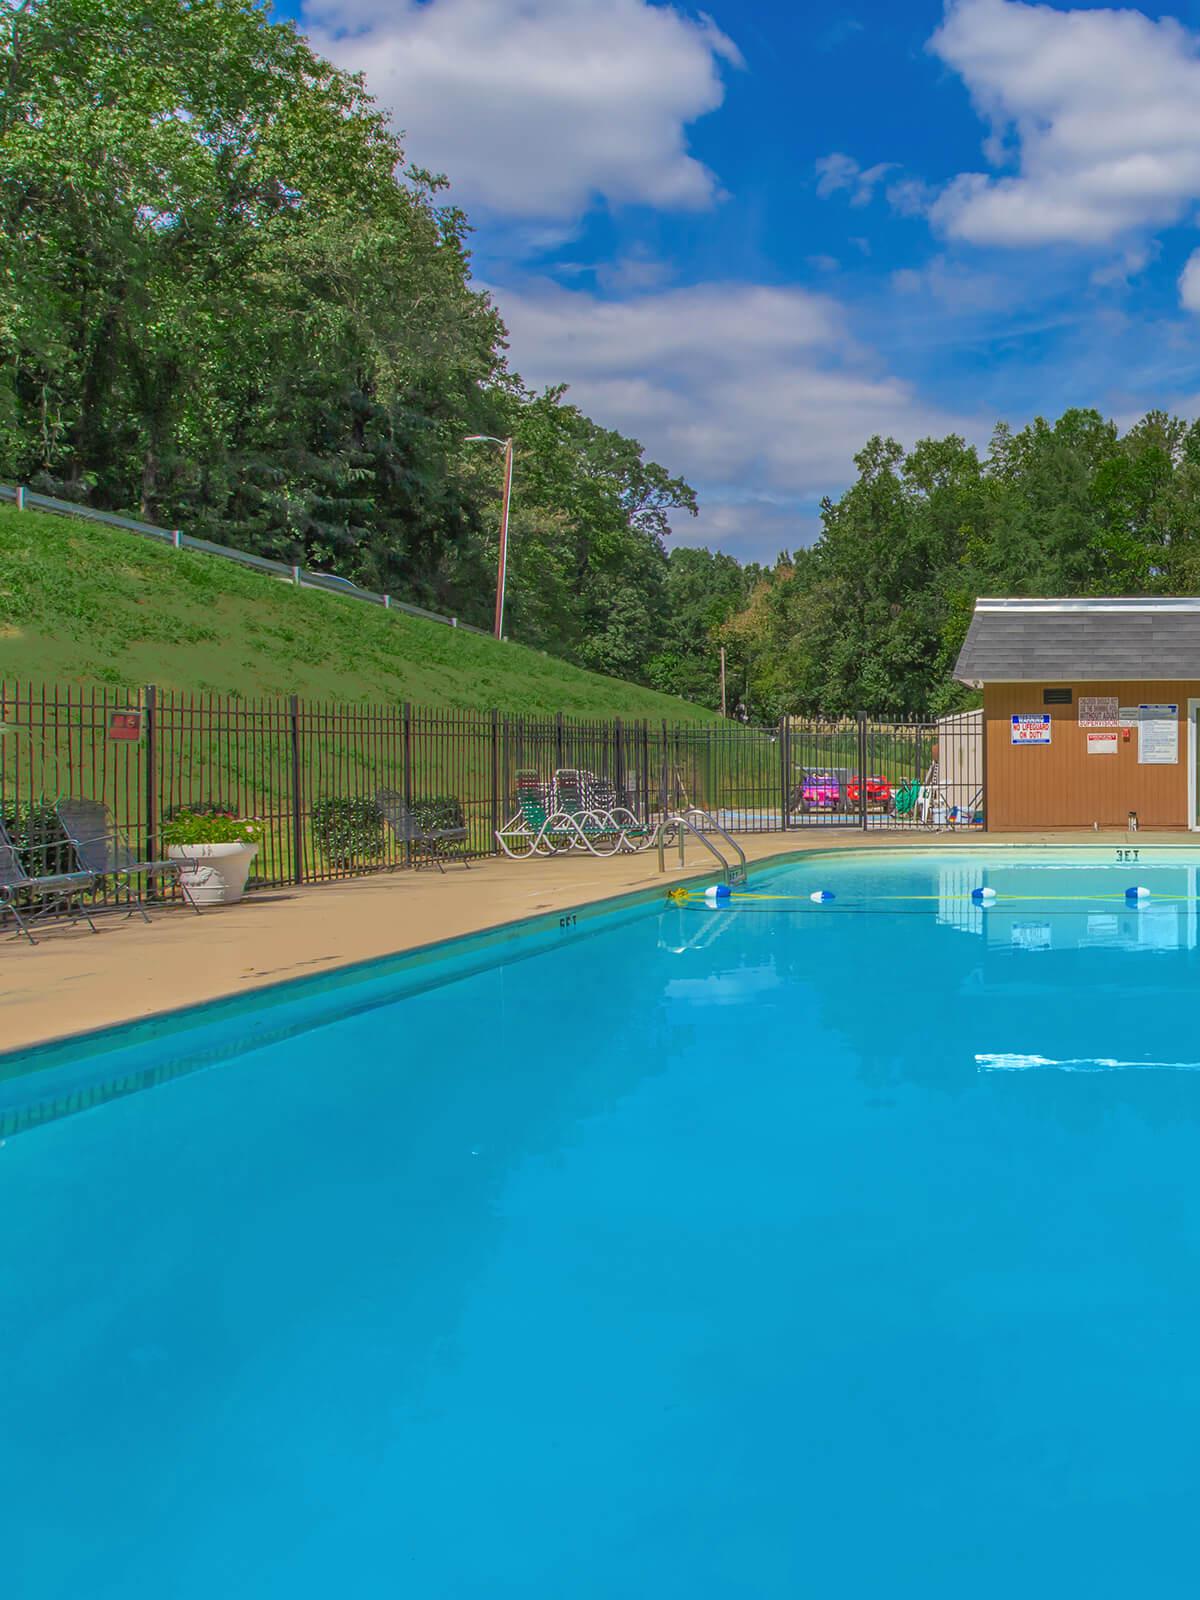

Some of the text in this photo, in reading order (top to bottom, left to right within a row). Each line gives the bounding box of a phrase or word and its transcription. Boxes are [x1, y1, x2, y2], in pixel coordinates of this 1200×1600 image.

[1022, 723, 1049, 731] LIFEGUARD
[1020, 731, 1043, 739] ON DUTY
